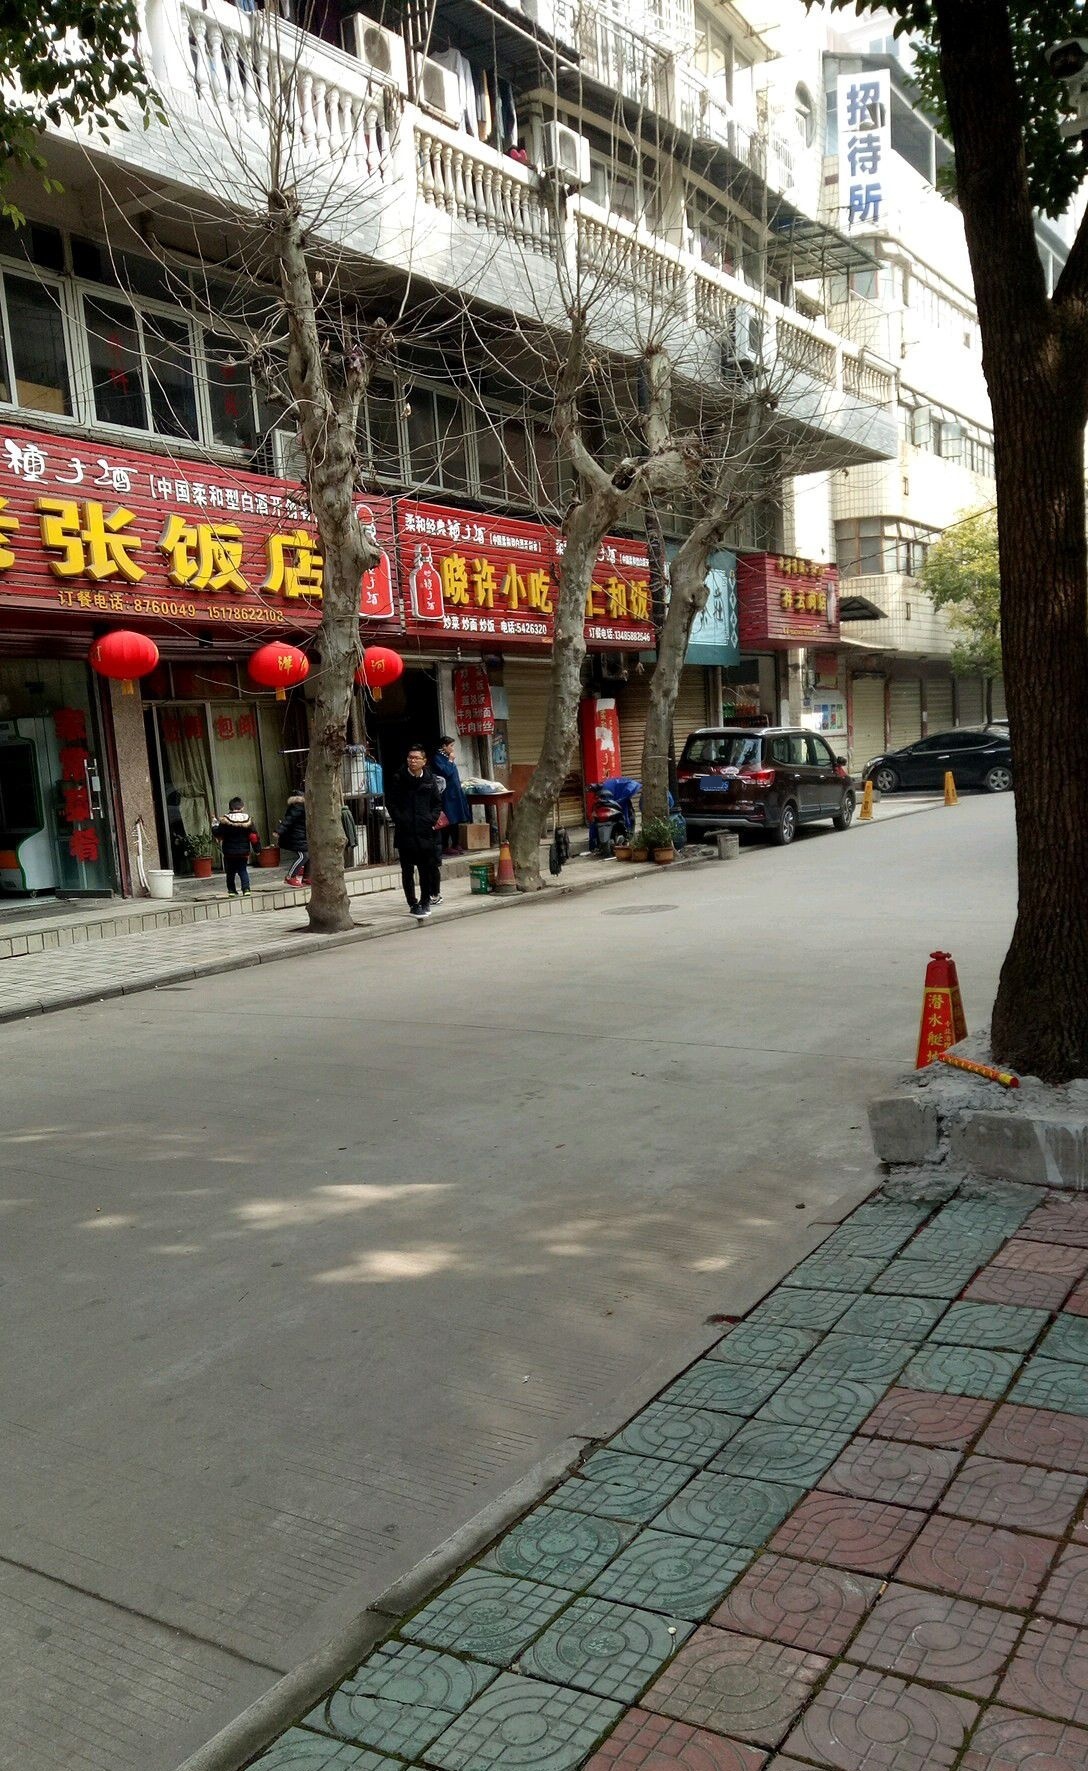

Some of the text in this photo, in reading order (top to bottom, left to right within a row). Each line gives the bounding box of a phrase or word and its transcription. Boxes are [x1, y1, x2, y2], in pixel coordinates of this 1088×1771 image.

[846, 81, 883, 224] 招待所
[439, 552, 554, 616] 晓许小吃
